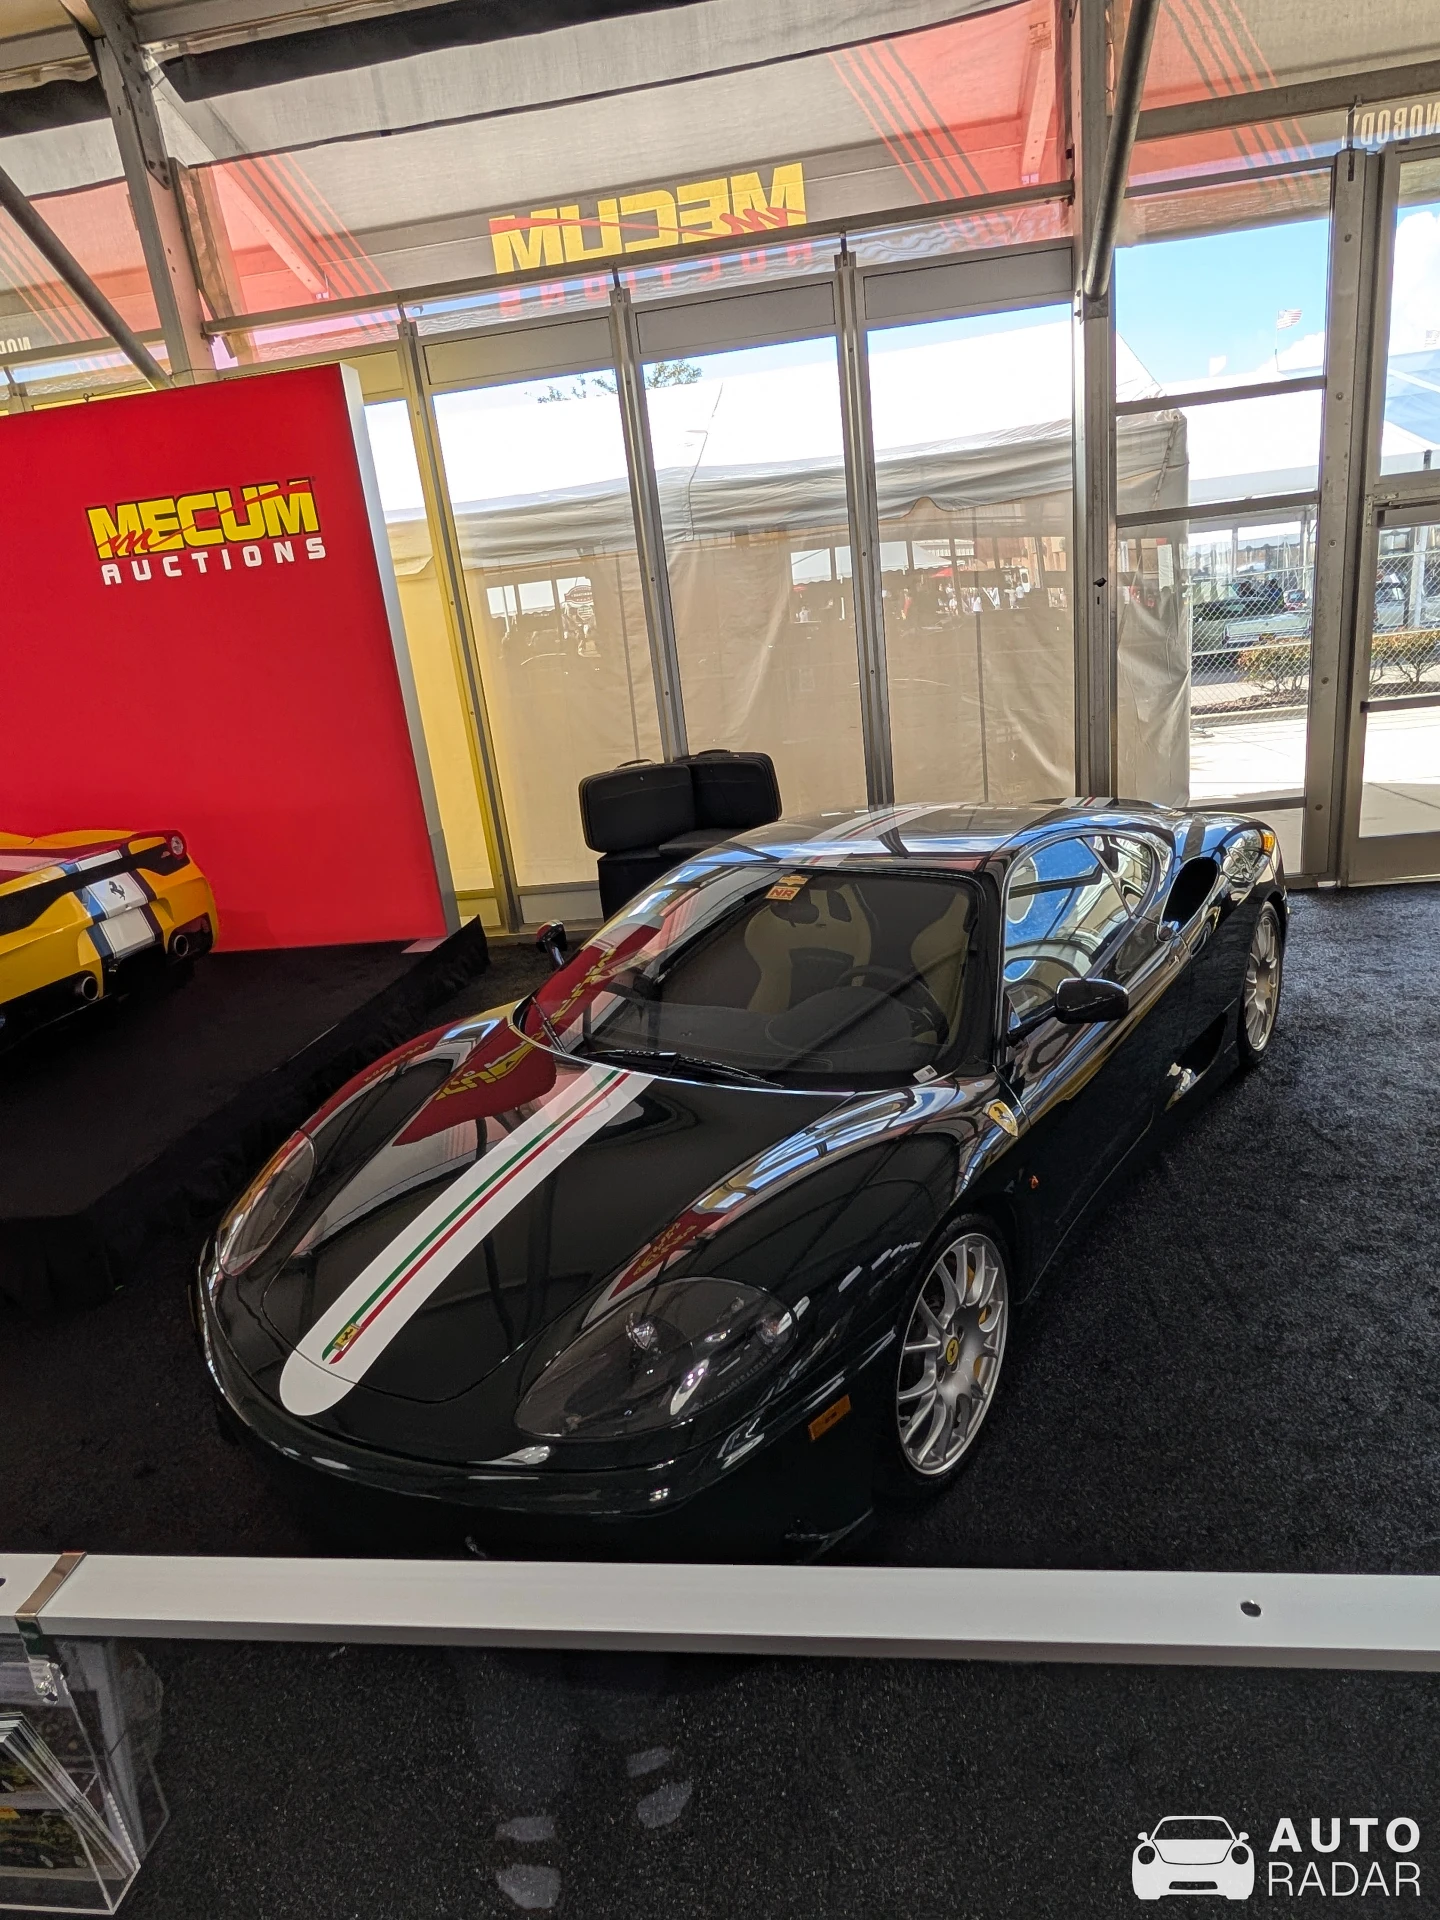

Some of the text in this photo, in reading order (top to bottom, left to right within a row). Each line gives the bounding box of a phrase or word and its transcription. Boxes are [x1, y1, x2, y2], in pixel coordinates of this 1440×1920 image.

[86, 477, 320, 560] MECUM
[101, 537, 326, 585] AUCTIONS
[770, 888, 795, 897] NR
